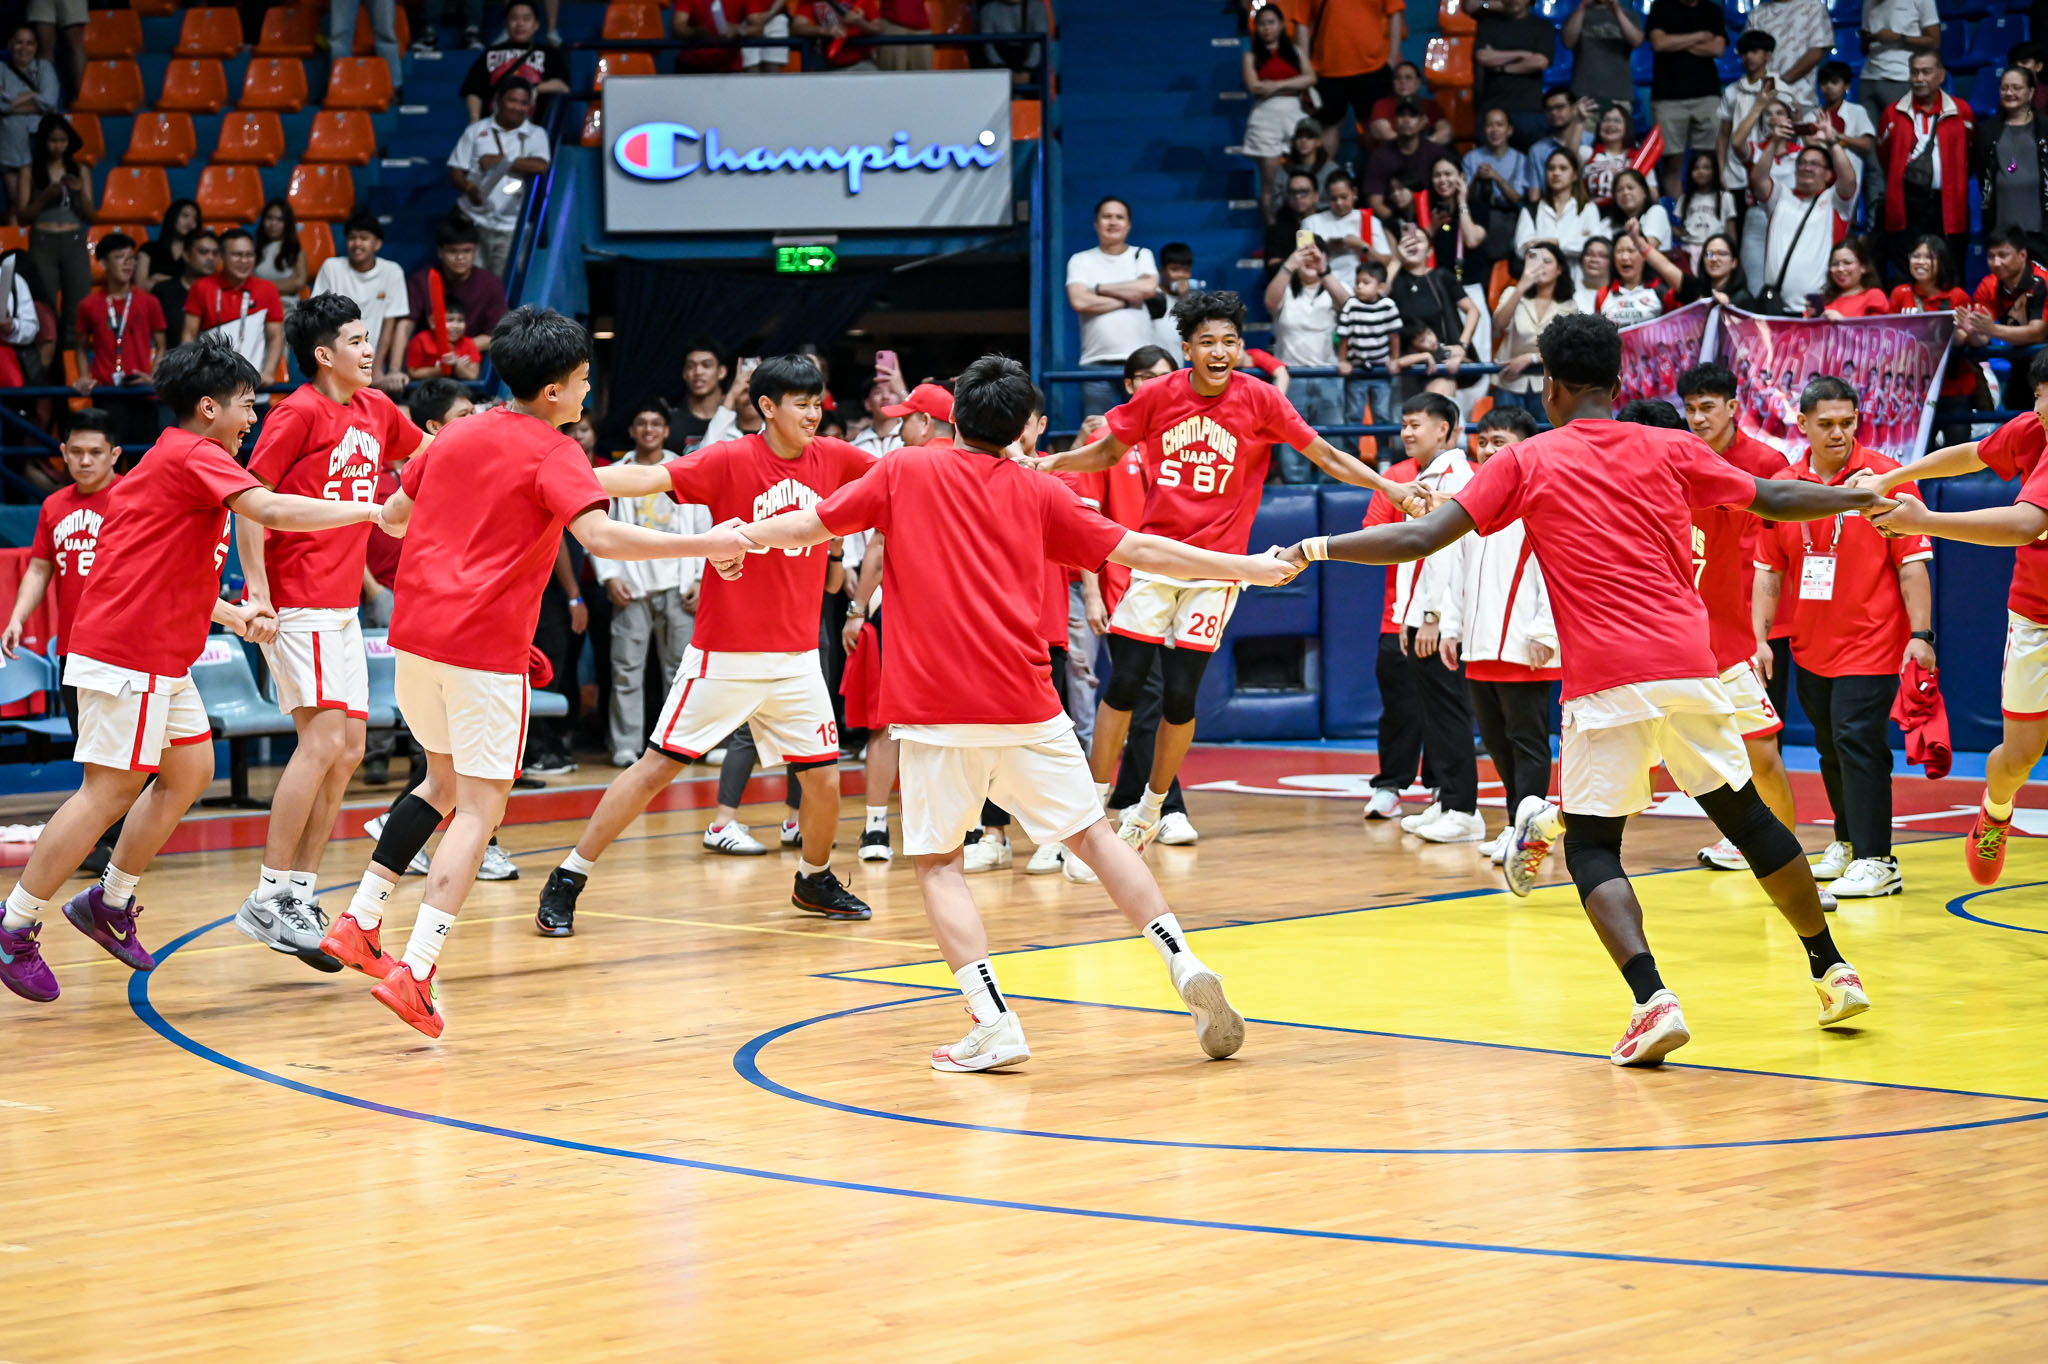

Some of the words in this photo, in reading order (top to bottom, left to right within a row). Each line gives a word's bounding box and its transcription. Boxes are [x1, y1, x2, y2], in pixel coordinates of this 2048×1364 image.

[614, 121, 1003, 194] Champion
[1162, 415, 1238, 464] CHAMPIONS
[1180, 449, 1217, 465] UAAP
[342, 463, 372, 478] UAAP
[1157, 459, 1183, 488] S
[1193, 465, 1235, 494] 87
[752, 478, 825, 521] CHAMPION
[53, 508, 105, 549] CHAMPIO
[64, 538, 97, 550] UAAP
[78, 551, 96, 576] 8
[1187, 612, 1218, 638] 28
[816, 720, 838, 746] 18
